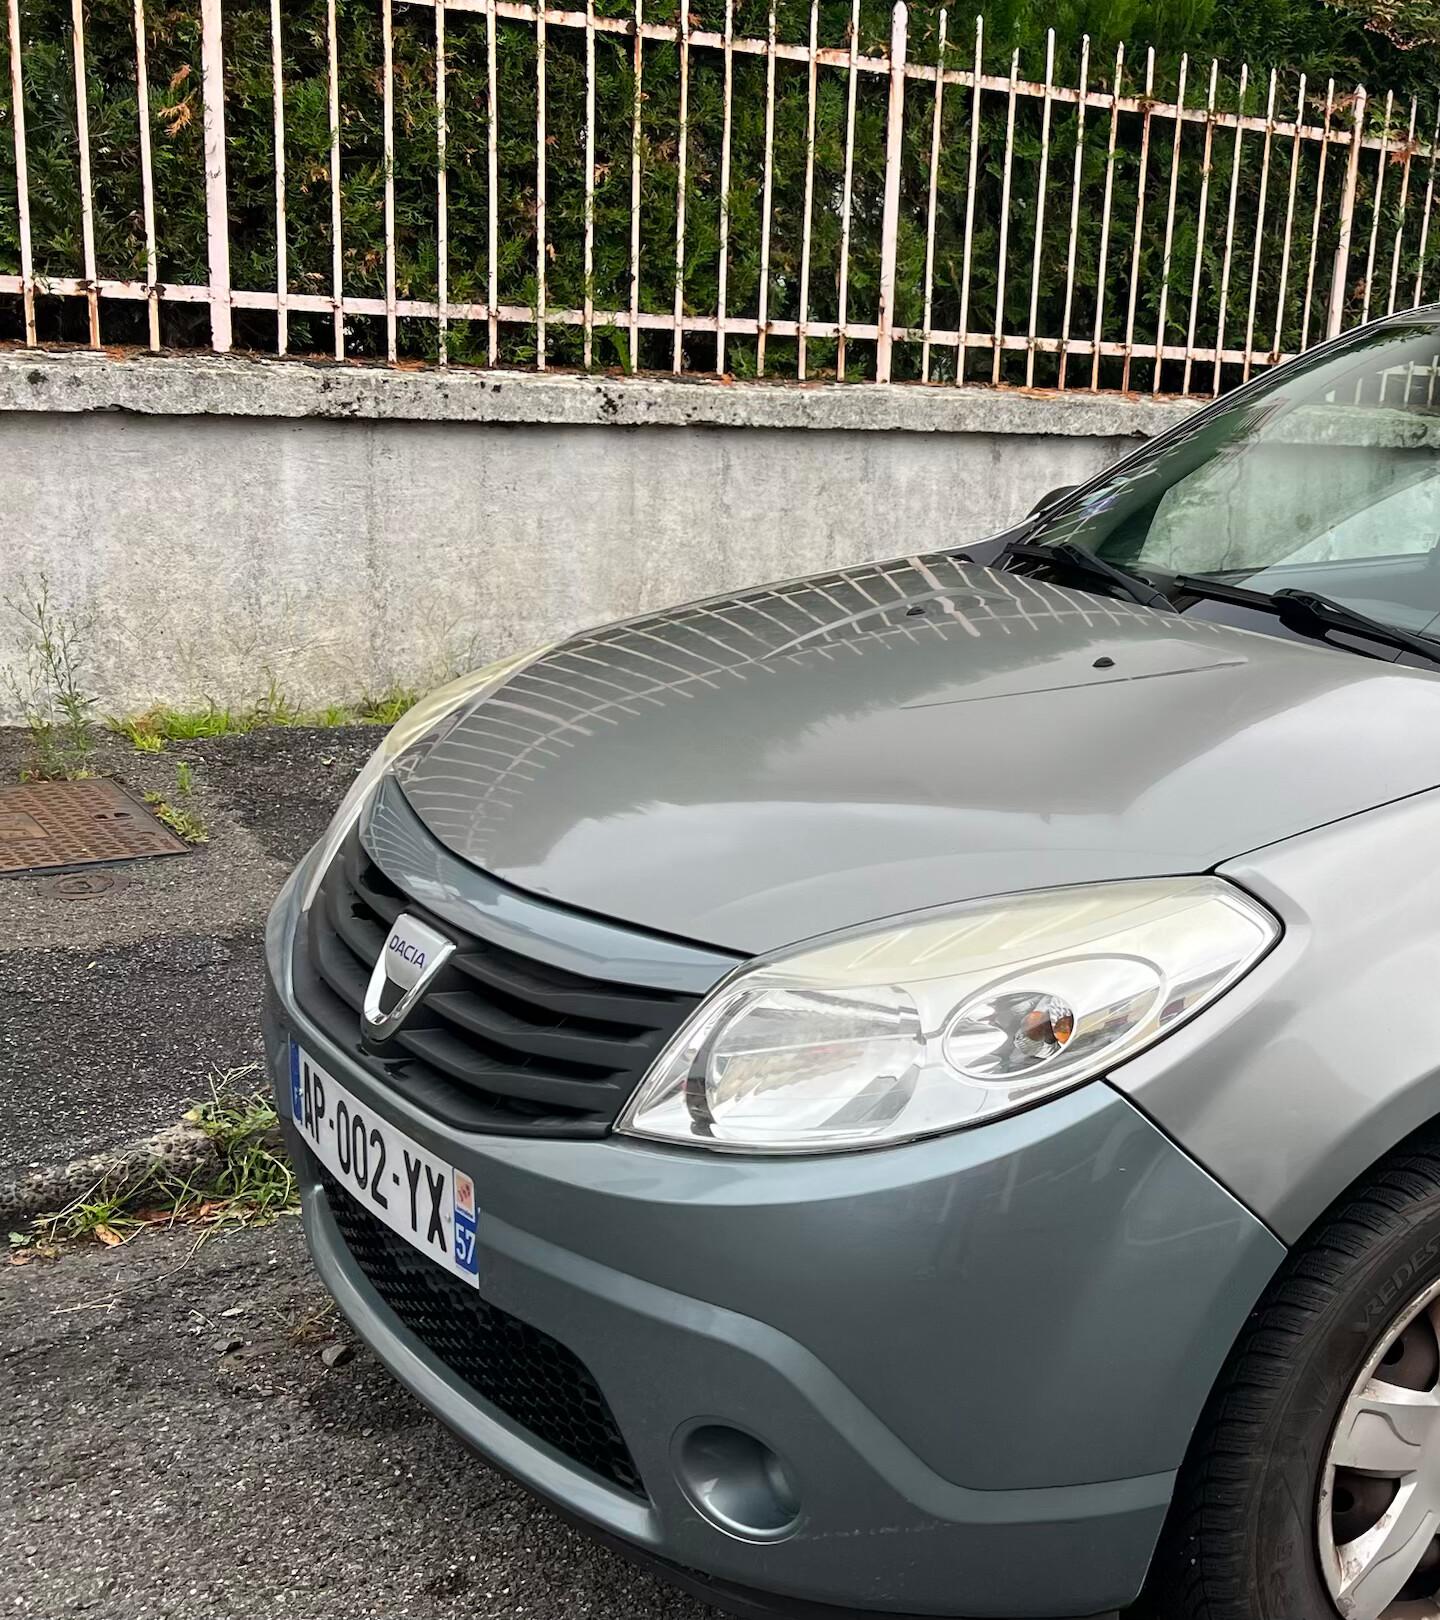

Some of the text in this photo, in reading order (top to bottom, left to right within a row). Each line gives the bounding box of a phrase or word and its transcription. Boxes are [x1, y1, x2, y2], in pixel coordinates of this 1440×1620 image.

[389, 934, 425, 968] DACIA
[304, 1061, 448, 1253] AP-002-YX
[455, 1222, 476, 1265] 57
